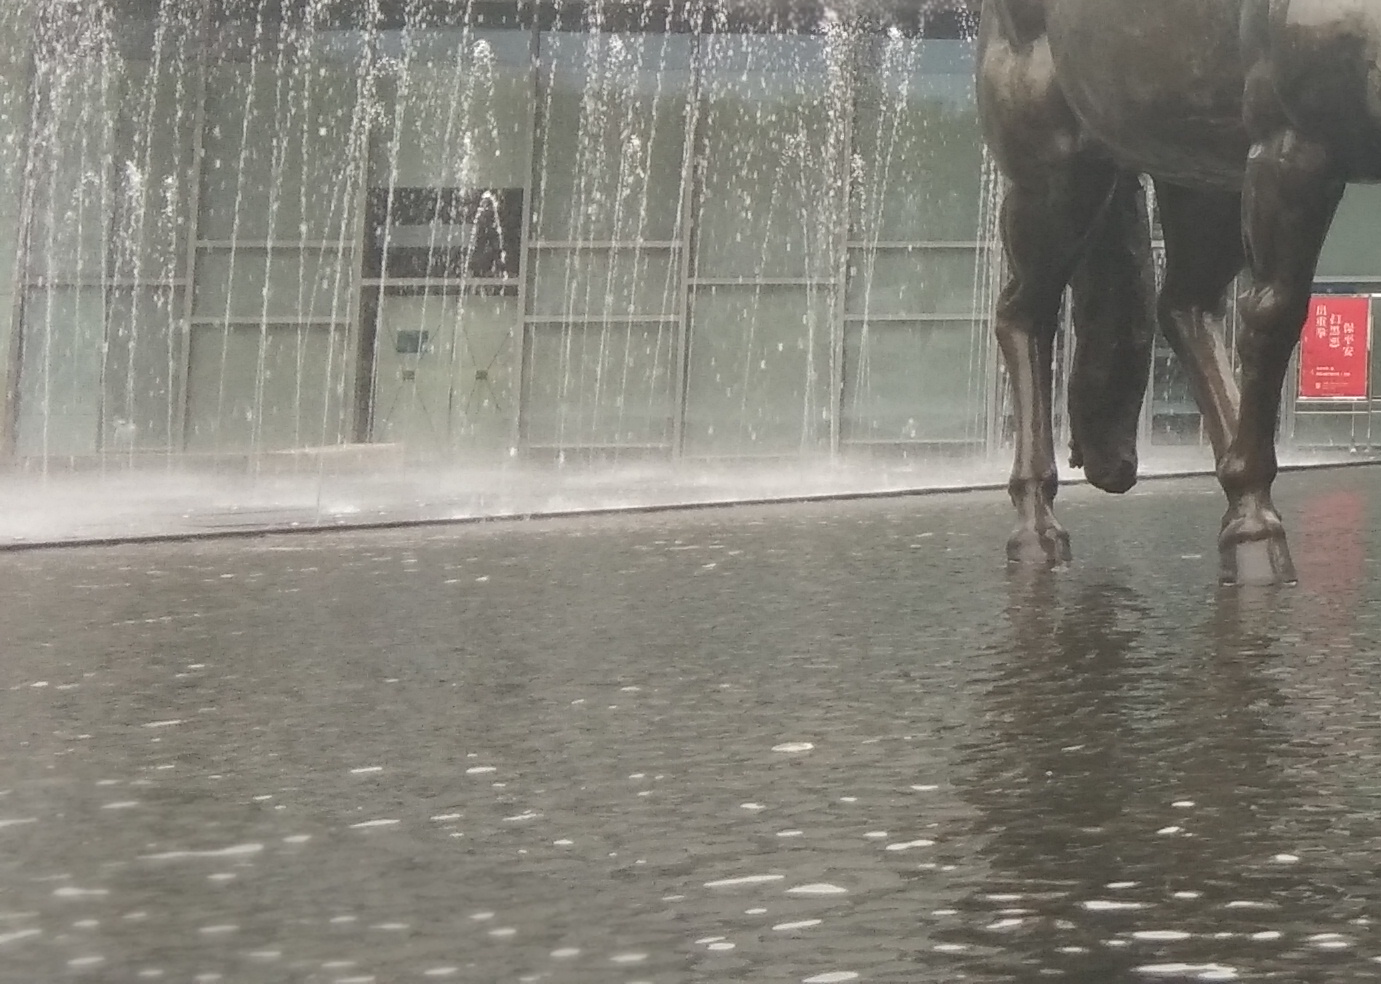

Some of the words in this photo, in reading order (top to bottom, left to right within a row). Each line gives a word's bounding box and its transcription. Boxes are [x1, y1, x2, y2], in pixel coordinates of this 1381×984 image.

[1316, 304, 1327, 339] 出重拳
[1329, 313, 1341, 348] 打黑恶
[1343, 322, 1354, 357] 保平安
